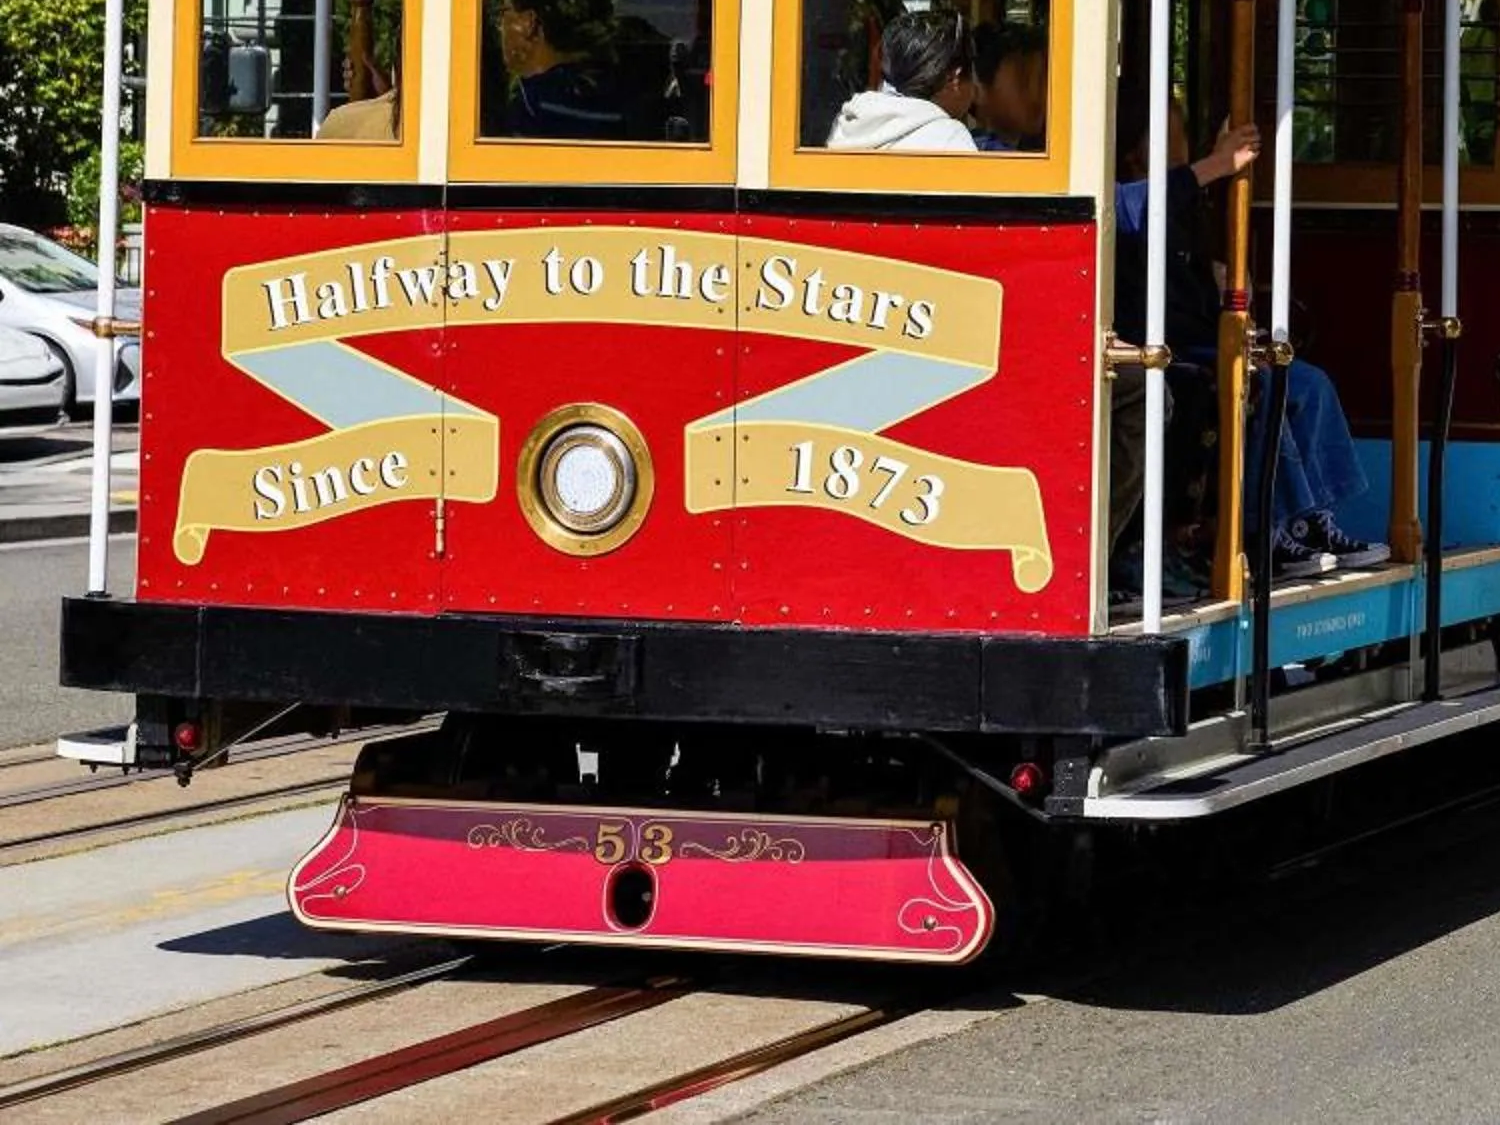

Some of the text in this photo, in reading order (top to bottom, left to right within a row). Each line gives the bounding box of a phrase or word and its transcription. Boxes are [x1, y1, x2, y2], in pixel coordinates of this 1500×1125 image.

[265, 243, 936, 341] Halfway to the Stars
[252, 438, 945, 528] Since 1873
[594, 823, 675, 866] 53
